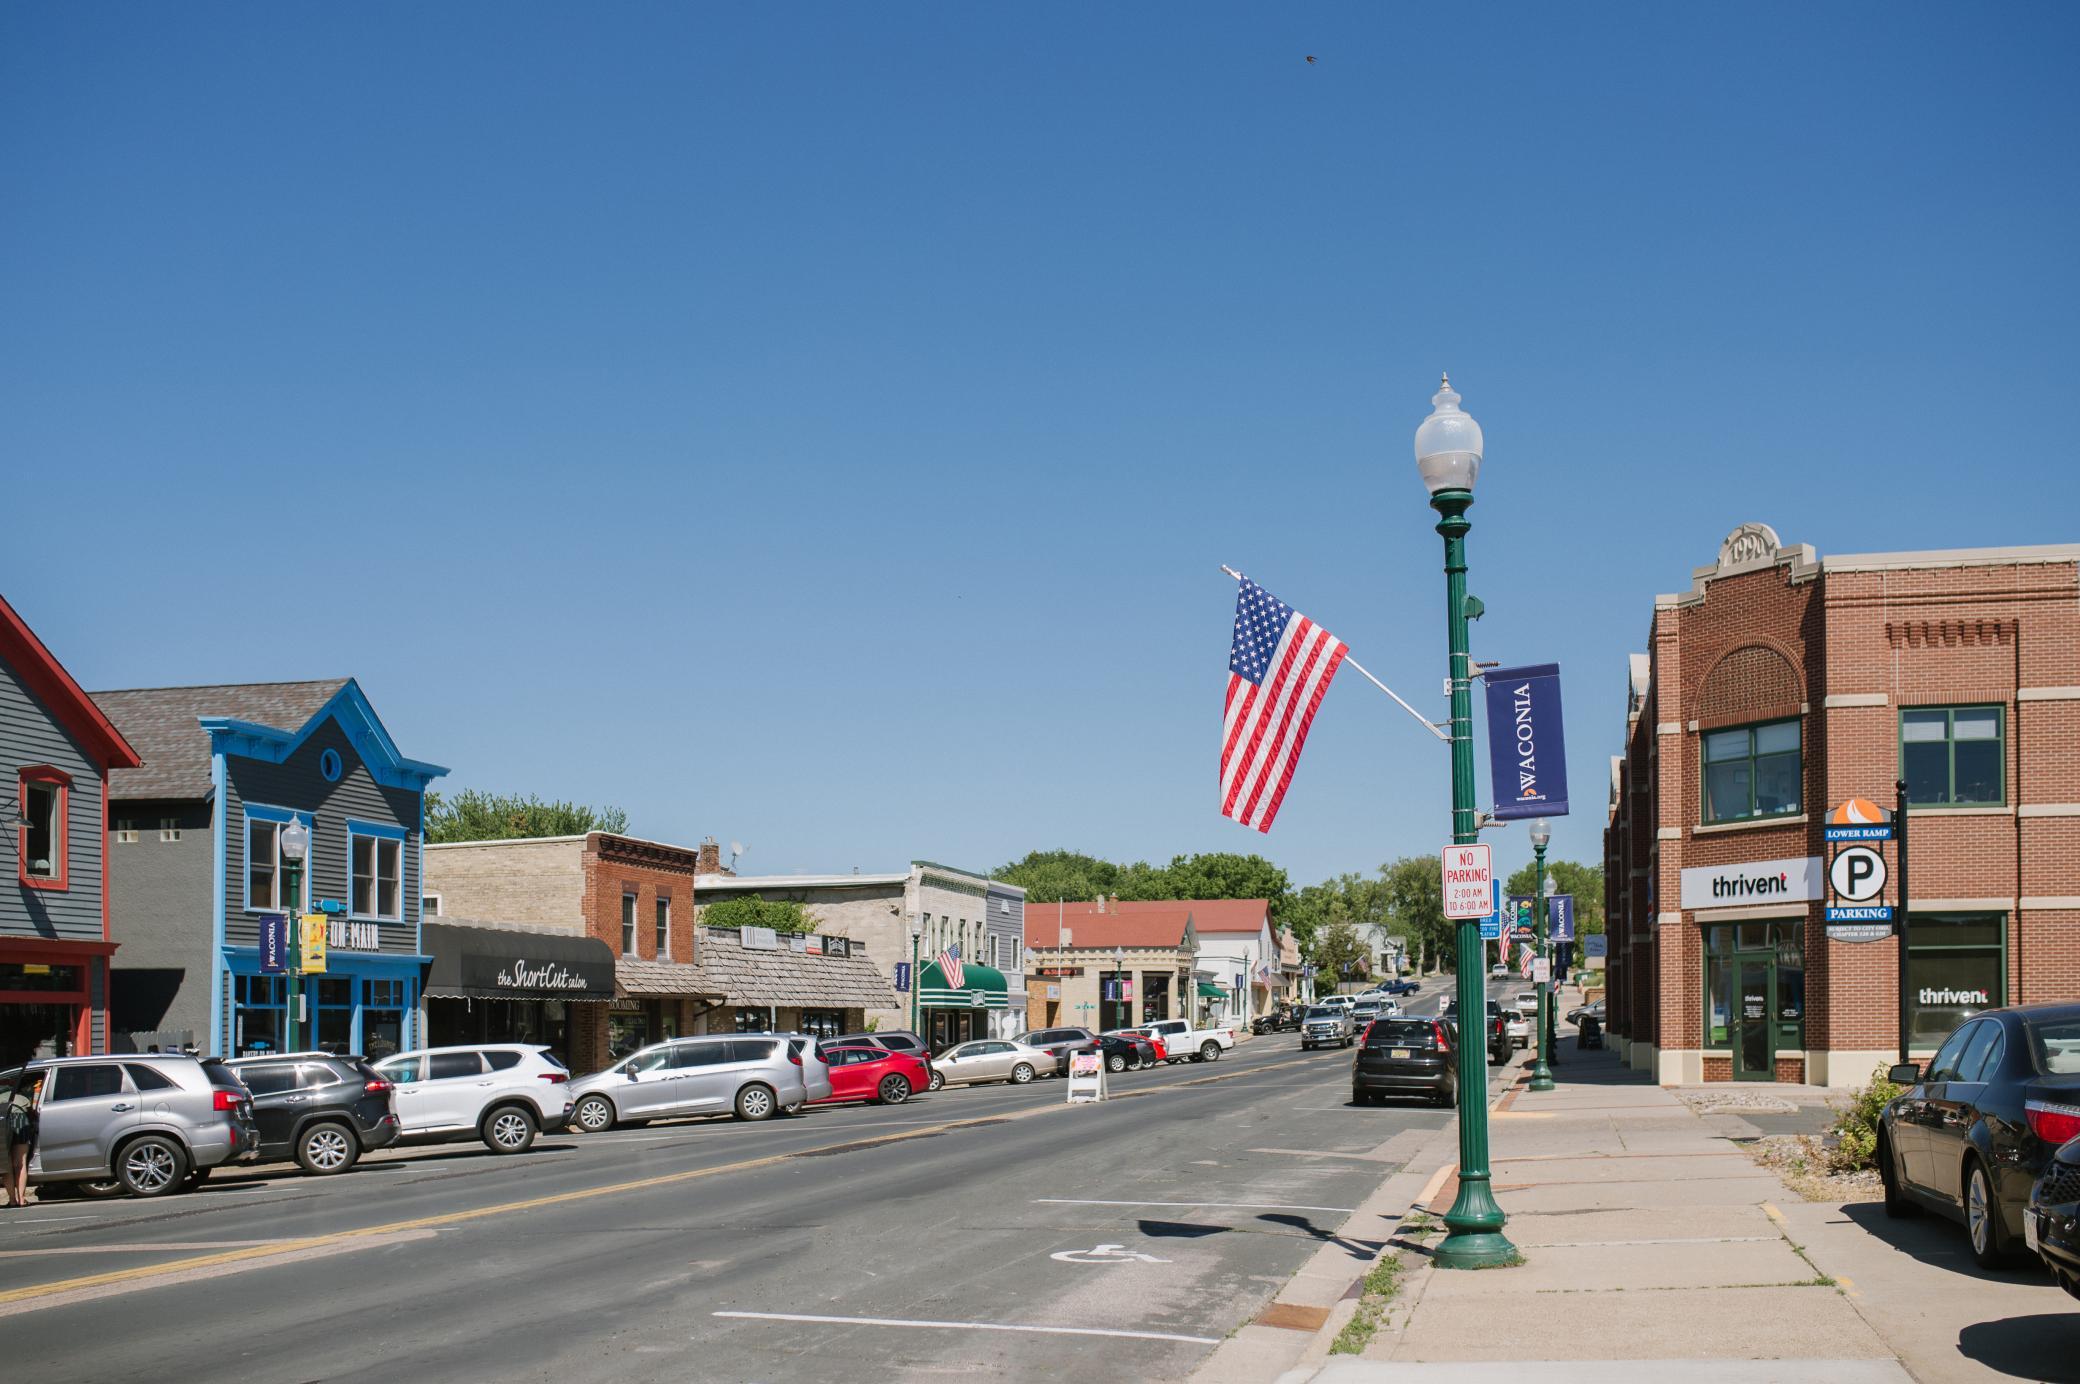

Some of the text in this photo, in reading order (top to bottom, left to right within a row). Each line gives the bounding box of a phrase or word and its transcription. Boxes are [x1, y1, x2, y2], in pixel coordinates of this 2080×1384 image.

[1513, 683, 1537, 791] WACONIA
[1828, 828, 1889, 839] LOWER RAMP
[1460, 853, 1474, 866] NO
[1448, 868, 1488, 883] PARKING
[1848, 855, 1874, 895] P
[1713, 872, 1787, 898] thrivent
[1454, 888, 1482, 899] 2:00 AM
[1449, 900, 1488, 910] TO 6:00 AM
[1830, 908, 1888, 919] PARKING
[268, 921, 276, 962] WACONIA
[330, 921, 346, 948] ON
[351, 922, 379, 949] MAIN
[498, 969, 512, 986] the
[568, 974, 587, 989] salon
[1919, 987, 1989, 1004] thrivent
[609, 1000, 640, 1010] ROOMING
